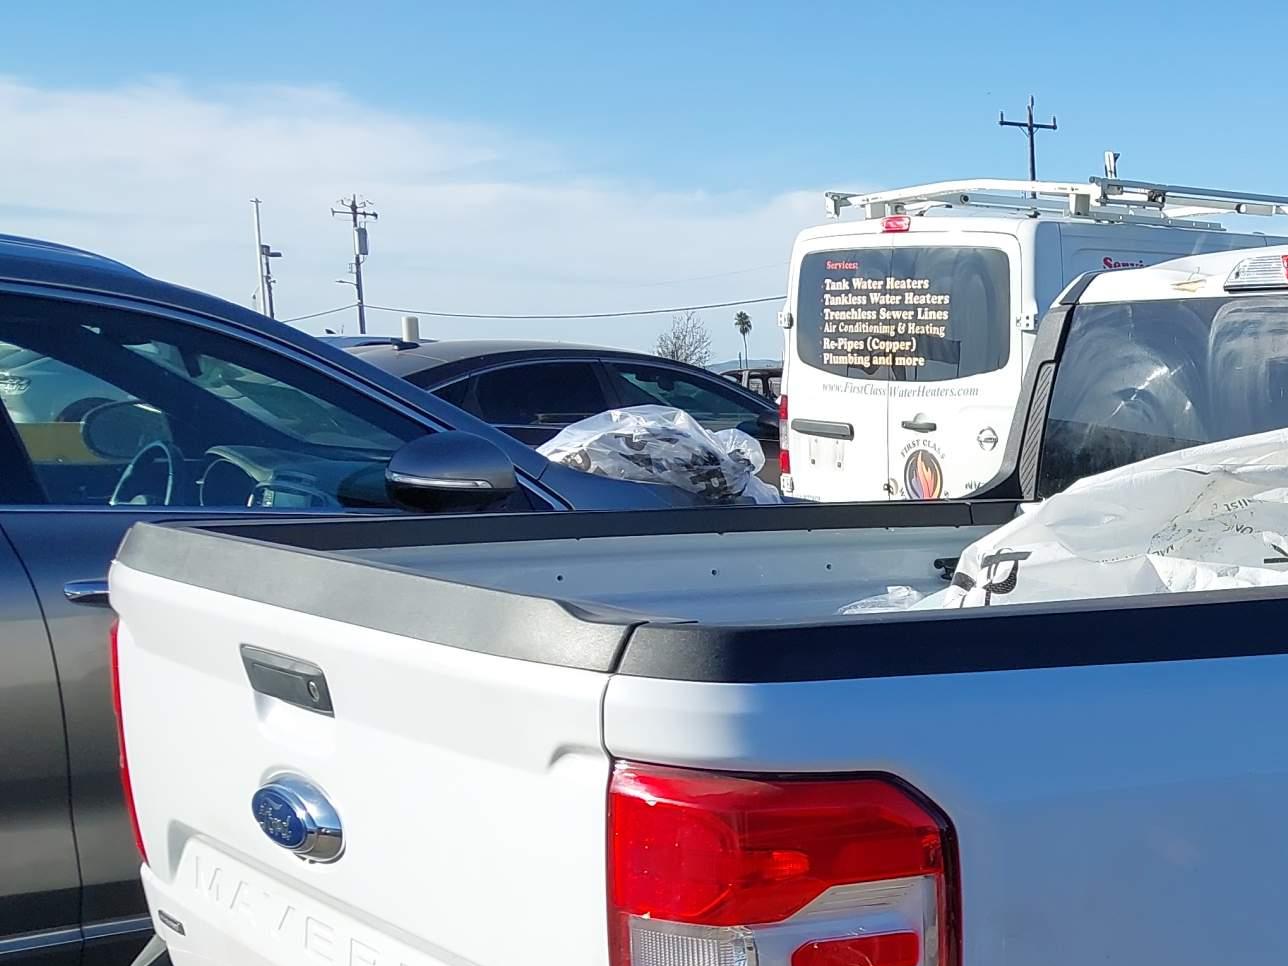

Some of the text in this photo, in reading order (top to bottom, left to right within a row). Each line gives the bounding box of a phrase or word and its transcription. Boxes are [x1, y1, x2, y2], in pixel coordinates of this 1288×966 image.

[826, 260, 859, 270] Services:
[824, 277, 929, 290] Tank Water Heaters
[824, 292, 950, 306] Tankless Water Heaters
[823, 307, 949, 320] Trenchless Sewer Lines
[824, 322, 946, 338] Air Conditioning & Heating
[823, 336, 917, 353] Re-Pipes (Copper)
[823, 353, 925, 367] Plumbing and more
[822, 381, 979, 398] www.FirstClassWaterHeaters.com
[901, 439, 945, 459] FIRST CLASS
